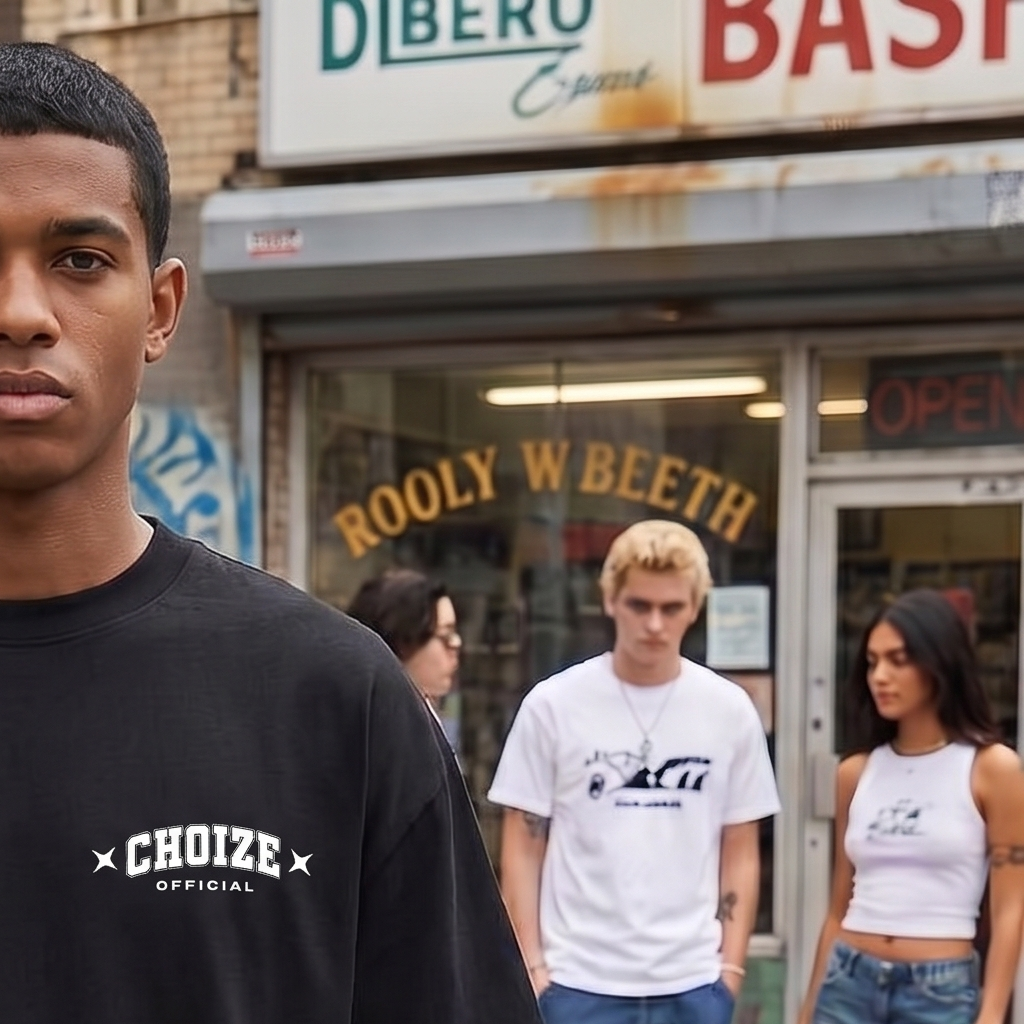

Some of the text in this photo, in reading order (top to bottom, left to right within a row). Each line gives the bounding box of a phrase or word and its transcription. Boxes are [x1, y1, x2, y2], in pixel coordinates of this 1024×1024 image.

[871, 375, 1024, 436] OPEN
[333, 445, 497, 558] ROOLY
[125, 823, 282, 880] CHOIZE
[156, 880, 254, 892] OFFICIAL
